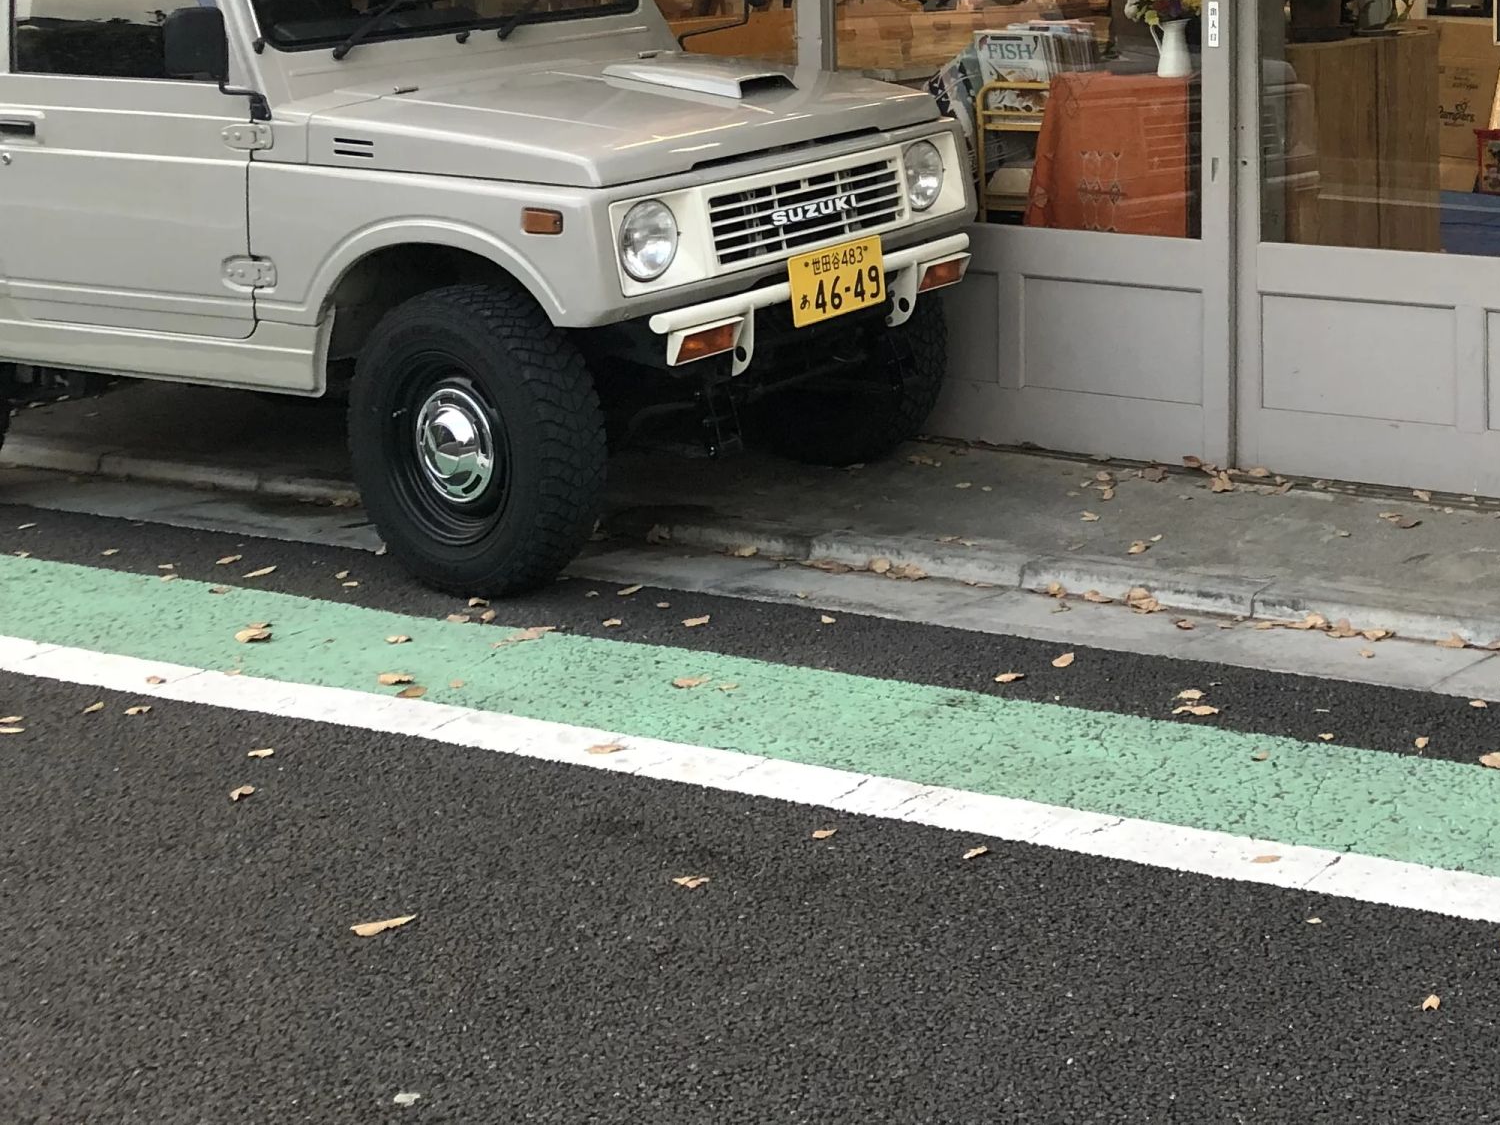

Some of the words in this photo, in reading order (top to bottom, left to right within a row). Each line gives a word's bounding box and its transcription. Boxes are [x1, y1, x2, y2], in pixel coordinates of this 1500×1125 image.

[1209, 7, 1217, 42] 出入口
[986, 42, 1034, 61] FISH
[771, 194, 858, 227] SUZUKI
[815, 265, 881, 315] 46-49
